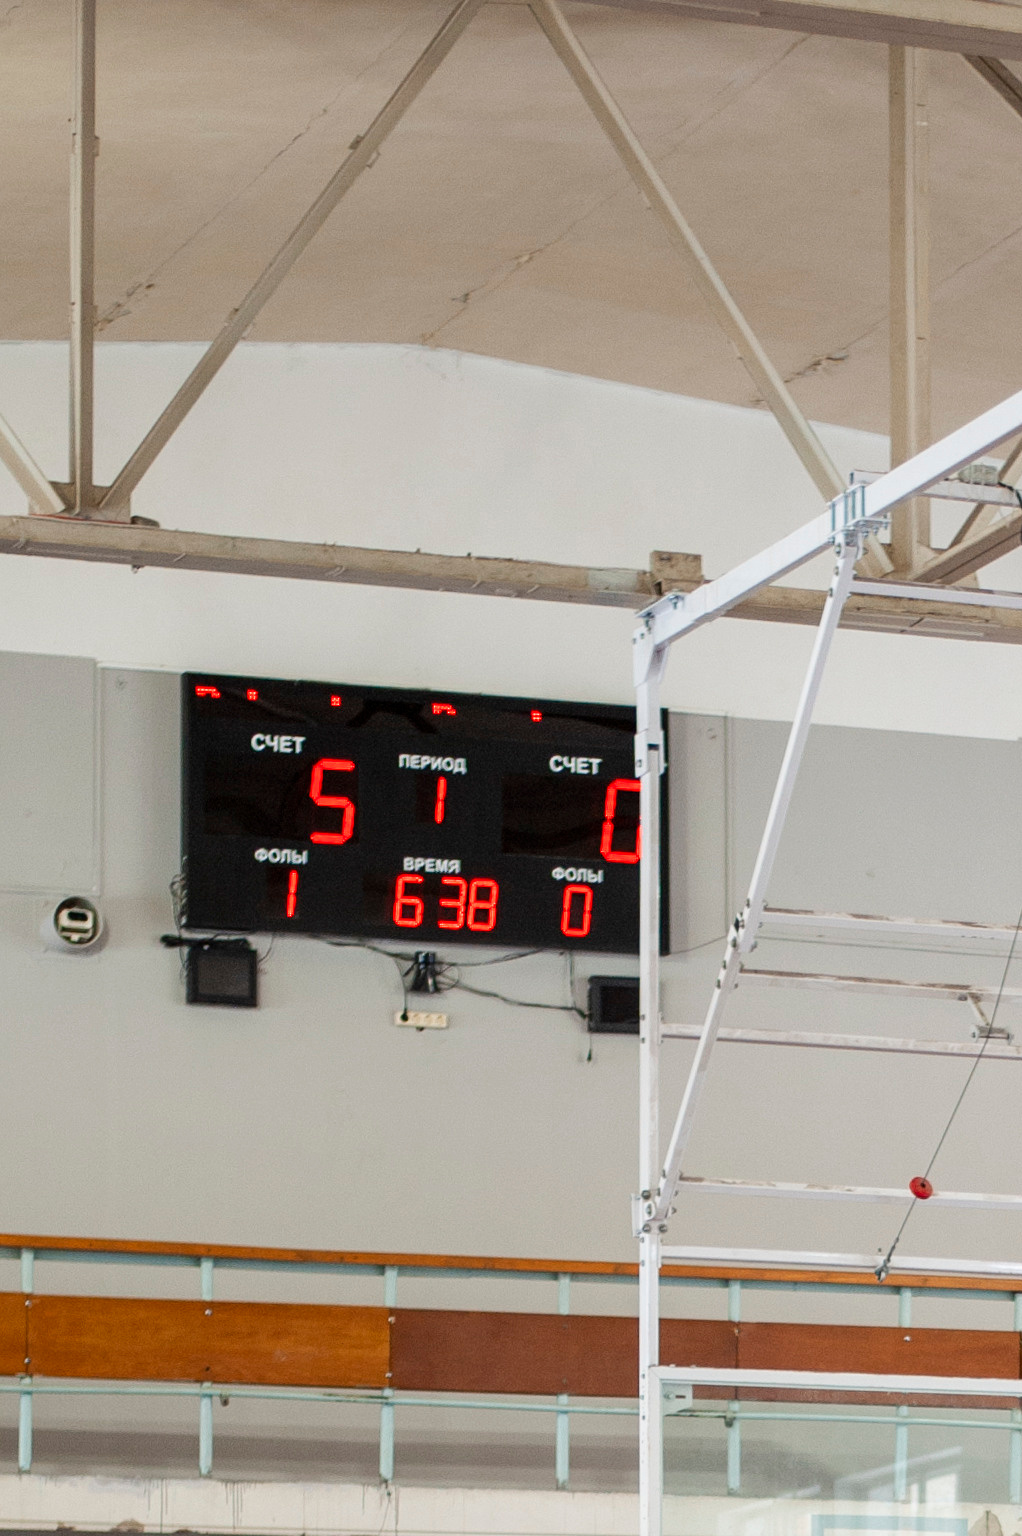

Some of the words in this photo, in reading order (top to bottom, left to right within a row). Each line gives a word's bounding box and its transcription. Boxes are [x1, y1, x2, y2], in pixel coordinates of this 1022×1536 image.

[250, 733, 306, 754] СЧЕТ
[398, 753, 468, 774] ПЕРИОД
[549, 755, 603, 775] СЧЕТ
[309, 758, 355, 845] 5
[434, 775, 447, 825] 1
[254, 848, 309, 865] ФОЛЫ
[403, 857, 461, 874] ВРЕМЯ
[551, 866, 604, 884] ФОЛЫ
[286, 869, 299, 918] 1
[560, 884, 594, 937] 0
